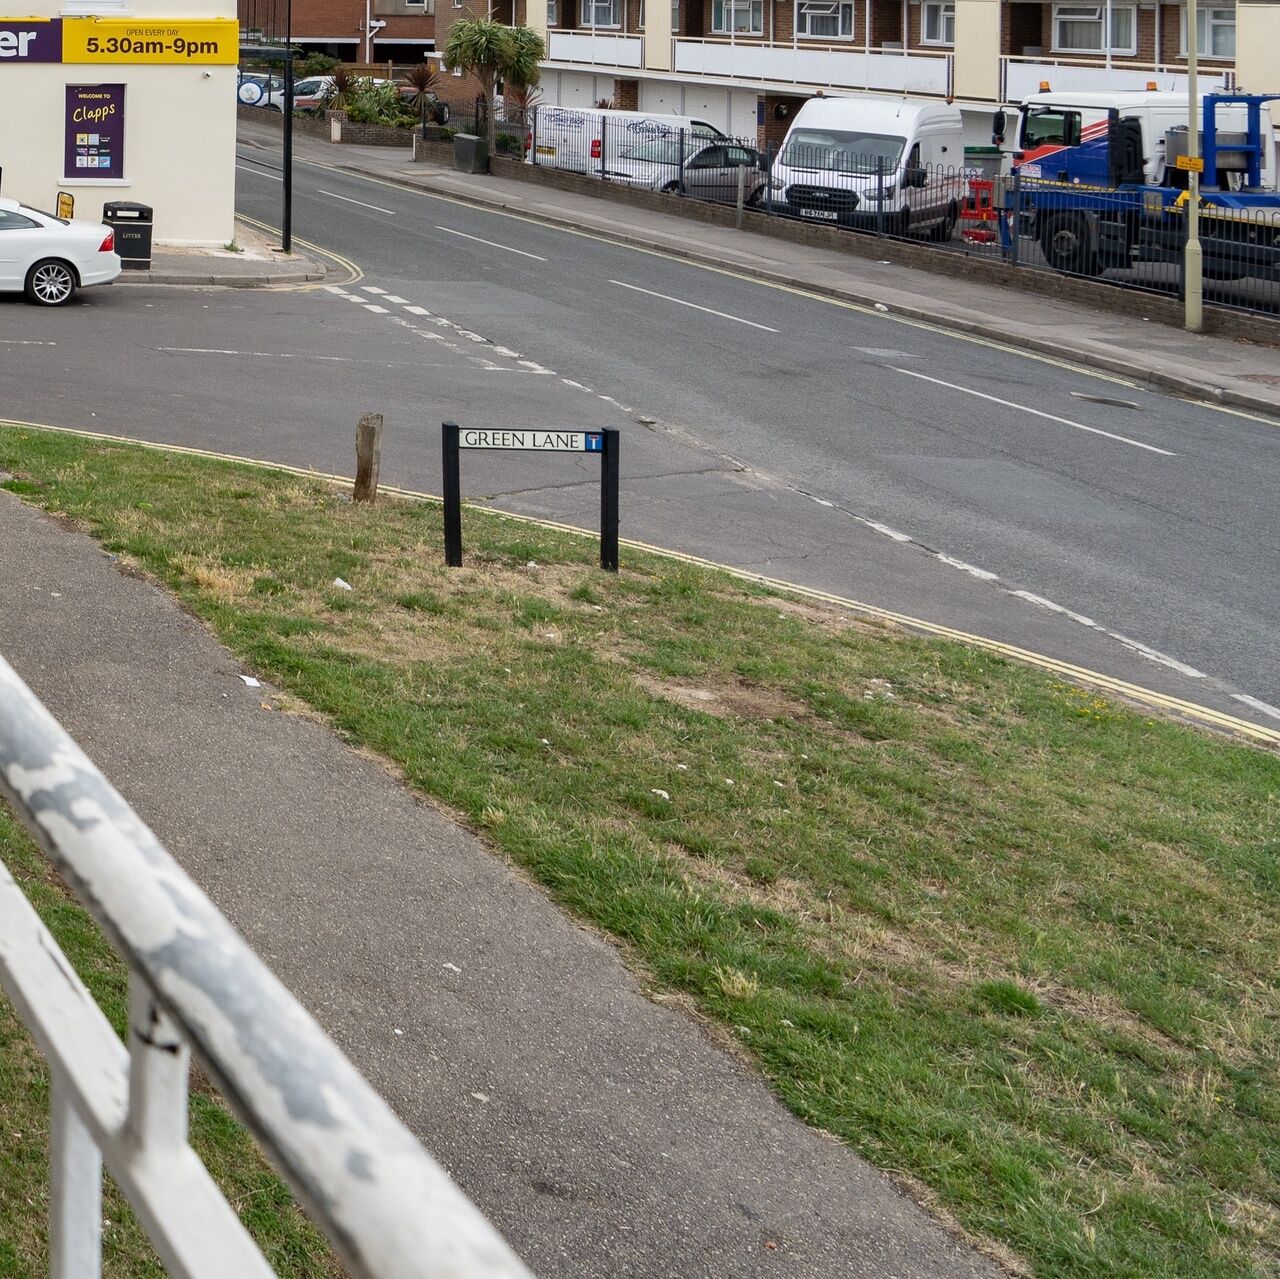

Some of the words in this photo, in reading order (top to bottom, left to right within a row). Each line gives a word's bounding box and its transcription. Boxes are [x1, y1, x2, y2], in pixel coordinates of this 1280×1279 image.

[86, 37, 219, 57] 5.30am-9pm
[73, 103, 115, 123] Clapps
[465, 431, 525, 447] GREEN
[532, 433, 579, 448] LANE
